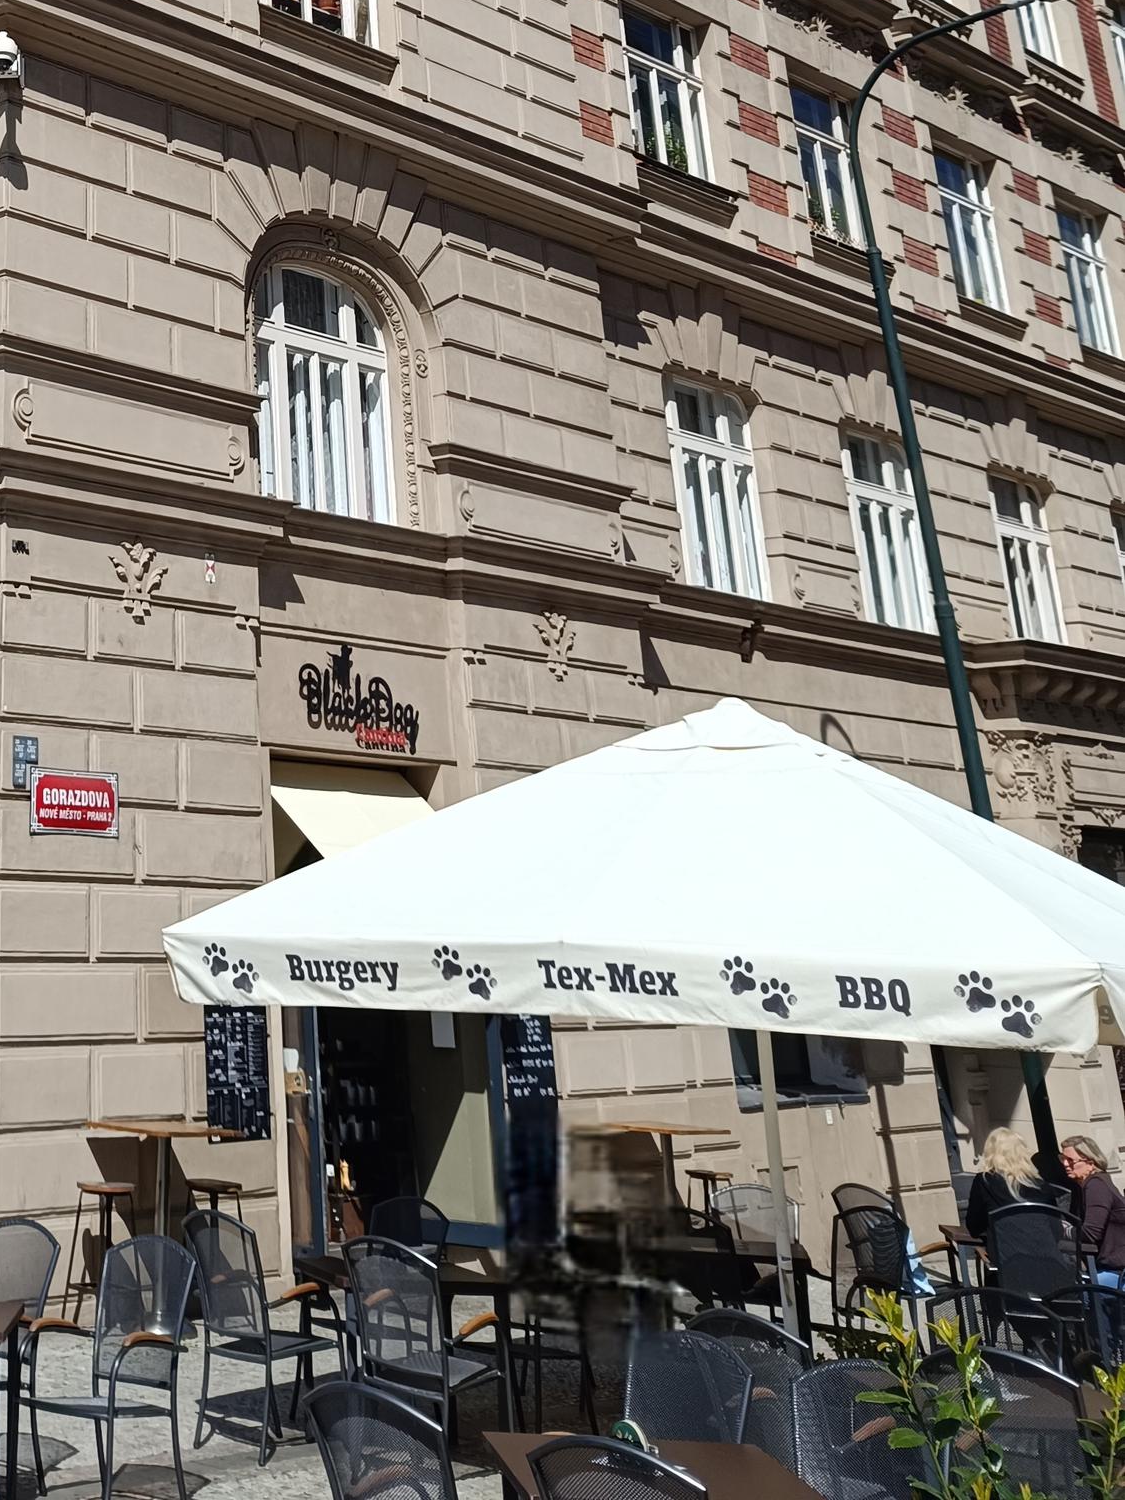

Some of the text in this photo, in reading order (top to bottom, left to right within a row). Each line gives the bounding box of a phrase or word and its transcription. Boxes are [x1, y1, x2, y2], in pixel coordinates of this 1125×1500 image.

[299, 663, 418, 752] Black Dog
[39, 807, 58, 819] NOVÉ
[59, 808, 81, 820] MĚSTO
[87, 811, 108, 822] PRAHA
[108, 812, 112, 822] 2
[42, 787, 110, 808] GORAZDOVA
[285, 953, 912, 1017] Burgery Tex-Mex BBQ
